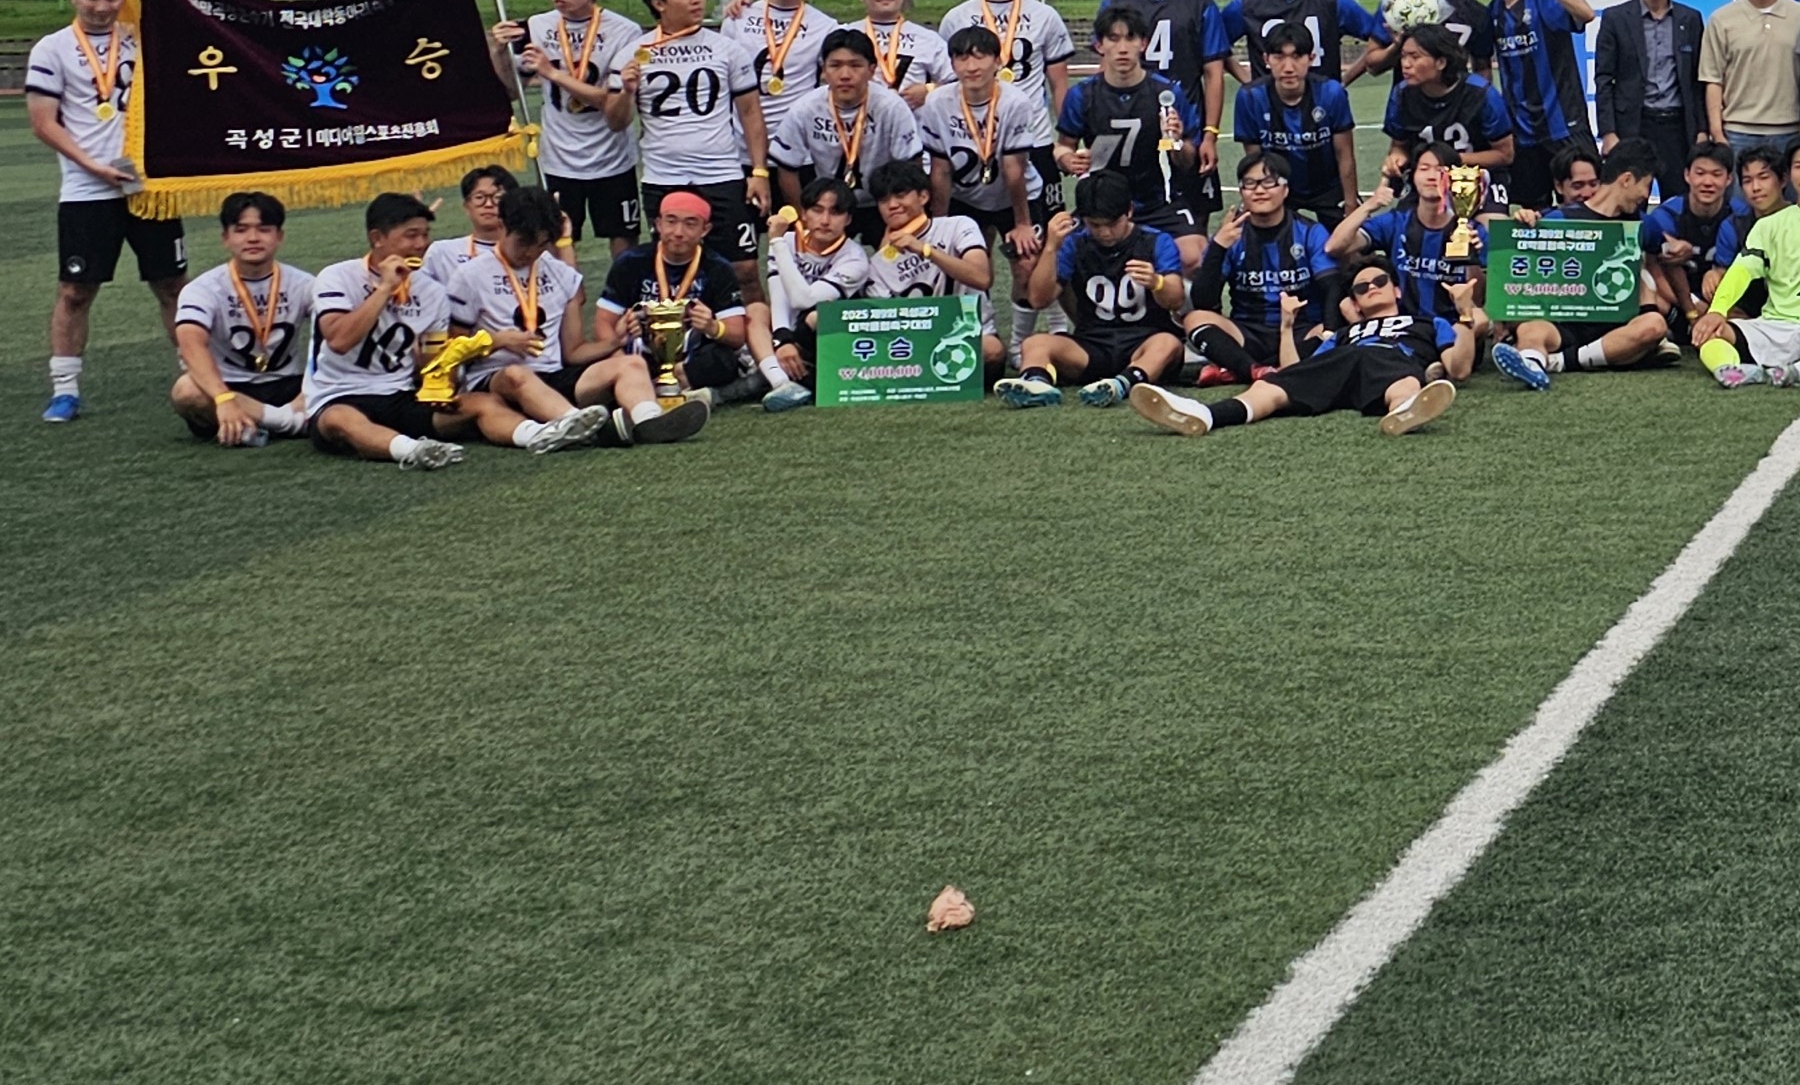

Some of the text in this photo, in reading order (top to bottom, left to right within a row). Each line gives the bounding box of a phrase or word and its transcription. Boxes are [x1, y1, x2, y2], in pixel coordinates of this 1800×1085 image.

[650, 44, 713, 57] SEOWON
[1145, 19, 1174, 70] 4
[649, 54, 713, 65] UNIVERSITY
[646, 67, 720, 117] 20
[1202, 176, 1214, 199] 4
[1490, 184, 1508, 204] 13
[621, 199, 640, 223] 12
[1235, 266, 1311, 286] 가천대학교
[1086, 274, 1148, 322] 99
[224, 322, 296, 373] 32
